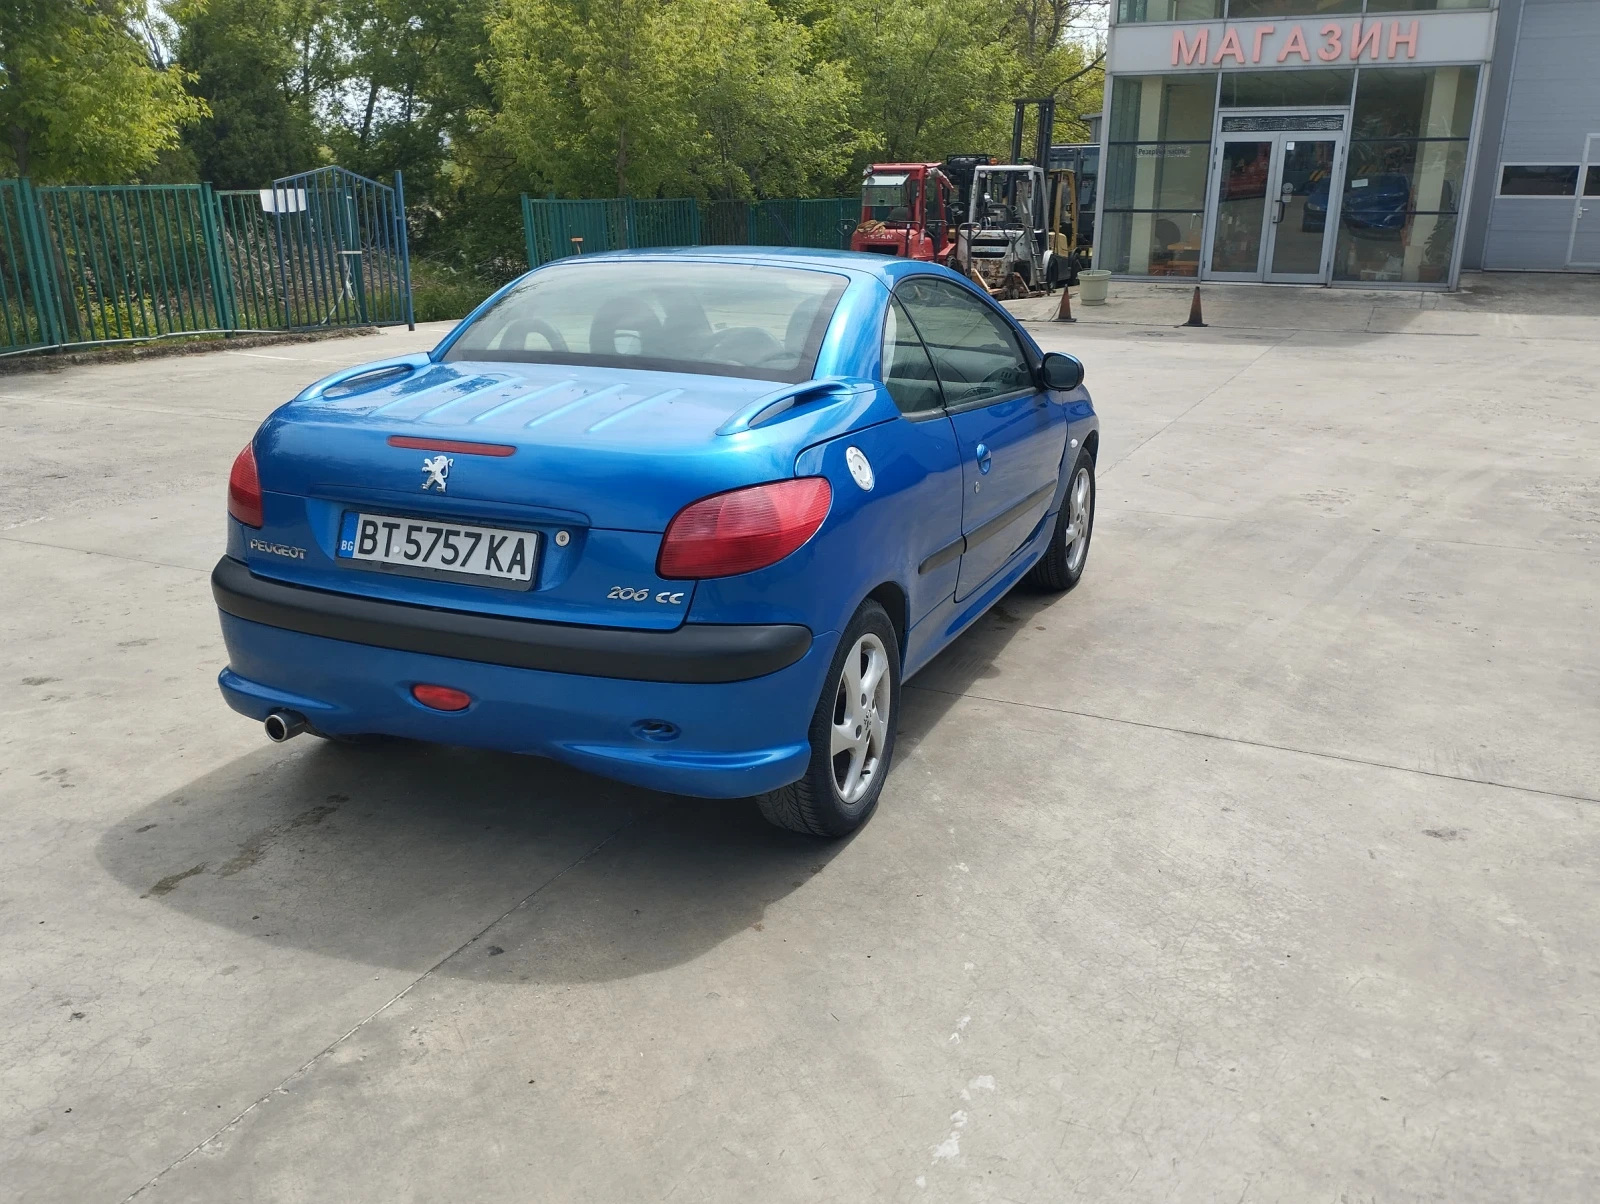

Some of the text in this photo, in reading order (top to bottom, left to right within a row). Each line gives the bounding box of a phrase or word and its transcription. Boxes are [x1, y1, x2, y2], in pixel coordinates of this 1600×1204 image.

[1170, 20, 1419, 66] МАГАЗИН
[1138, 148, 1165, 156] Резер
[250, 538, 307, 560] PEUGEOT
[341, 540, 354, 552] BG
[357, 519, 526, 575] BT 5757 KA
[606, 586, 650, 602] 206
